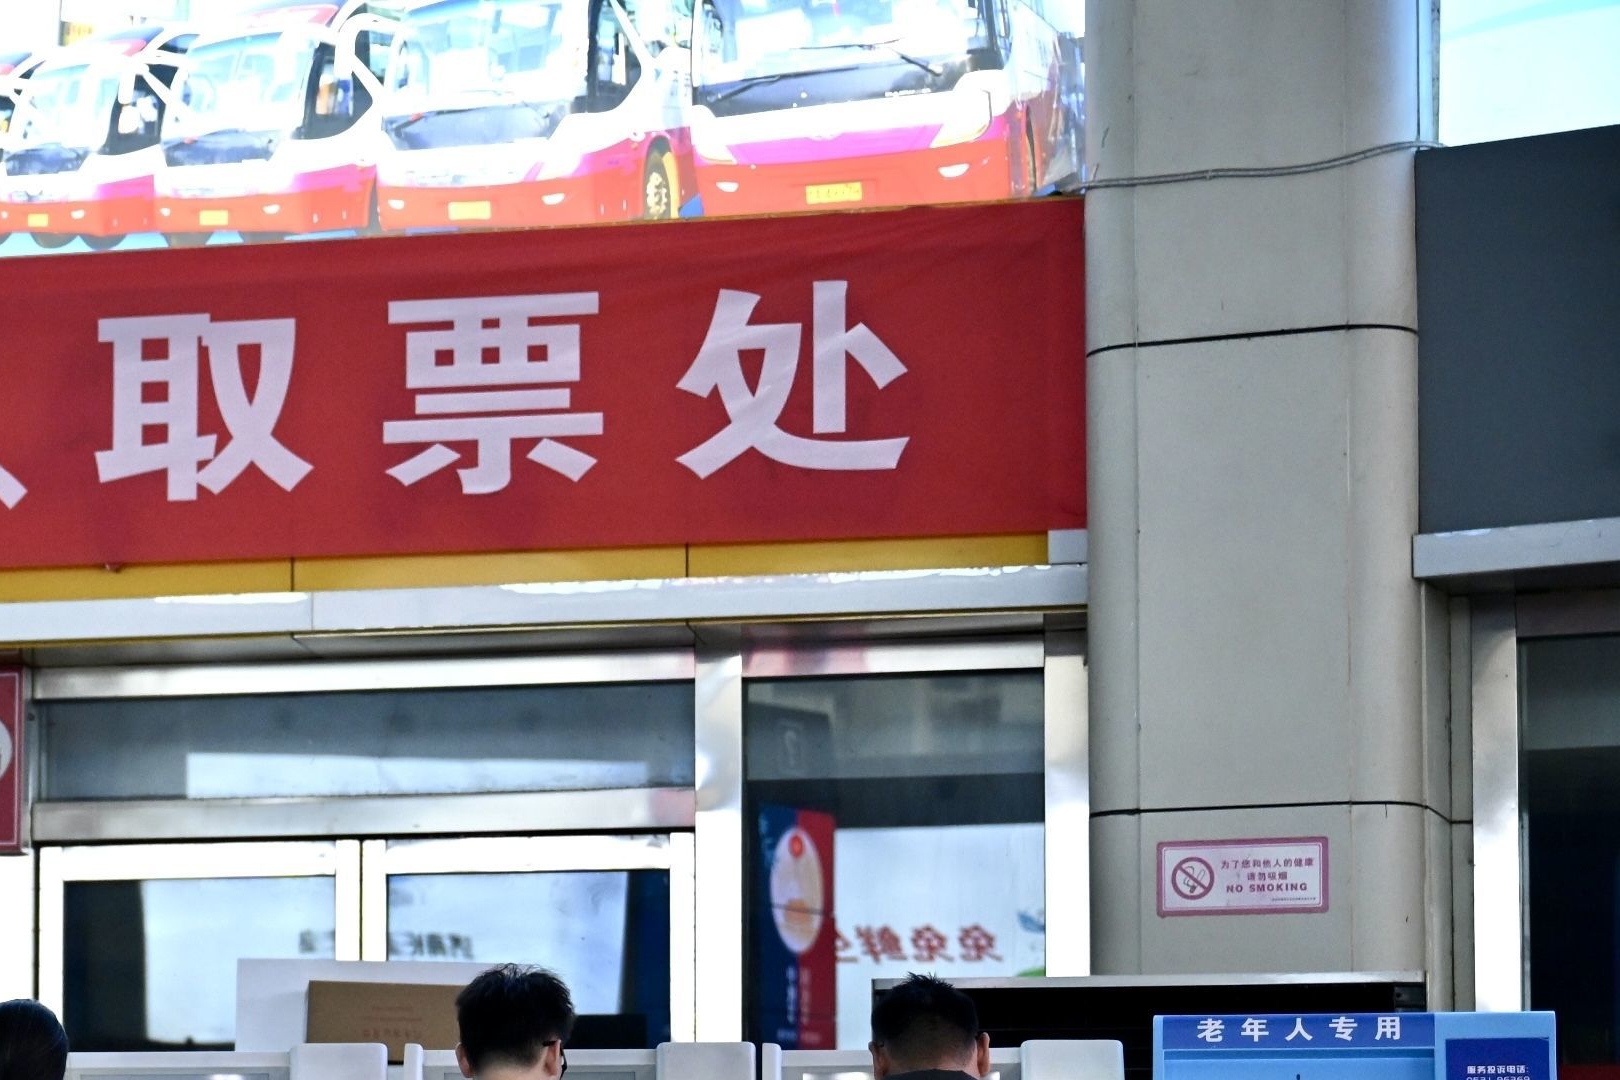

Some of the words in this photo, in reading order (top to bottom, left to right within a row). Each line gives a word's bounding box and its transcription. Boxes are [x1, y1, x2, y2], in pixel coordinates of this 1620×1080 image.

[1220, 857, 1315, 870] 为了您和他人的健康
[1247, 871, 1288, 882] 请勿吸烟
[1226, 884, 1244, 893] NO
[1249, 882, 1308, 893] SMOKING
[1196, 1015, 1402, 1043] 老年人专用
[1467, 1065, 1529, 1075] 服务投诉电话:
